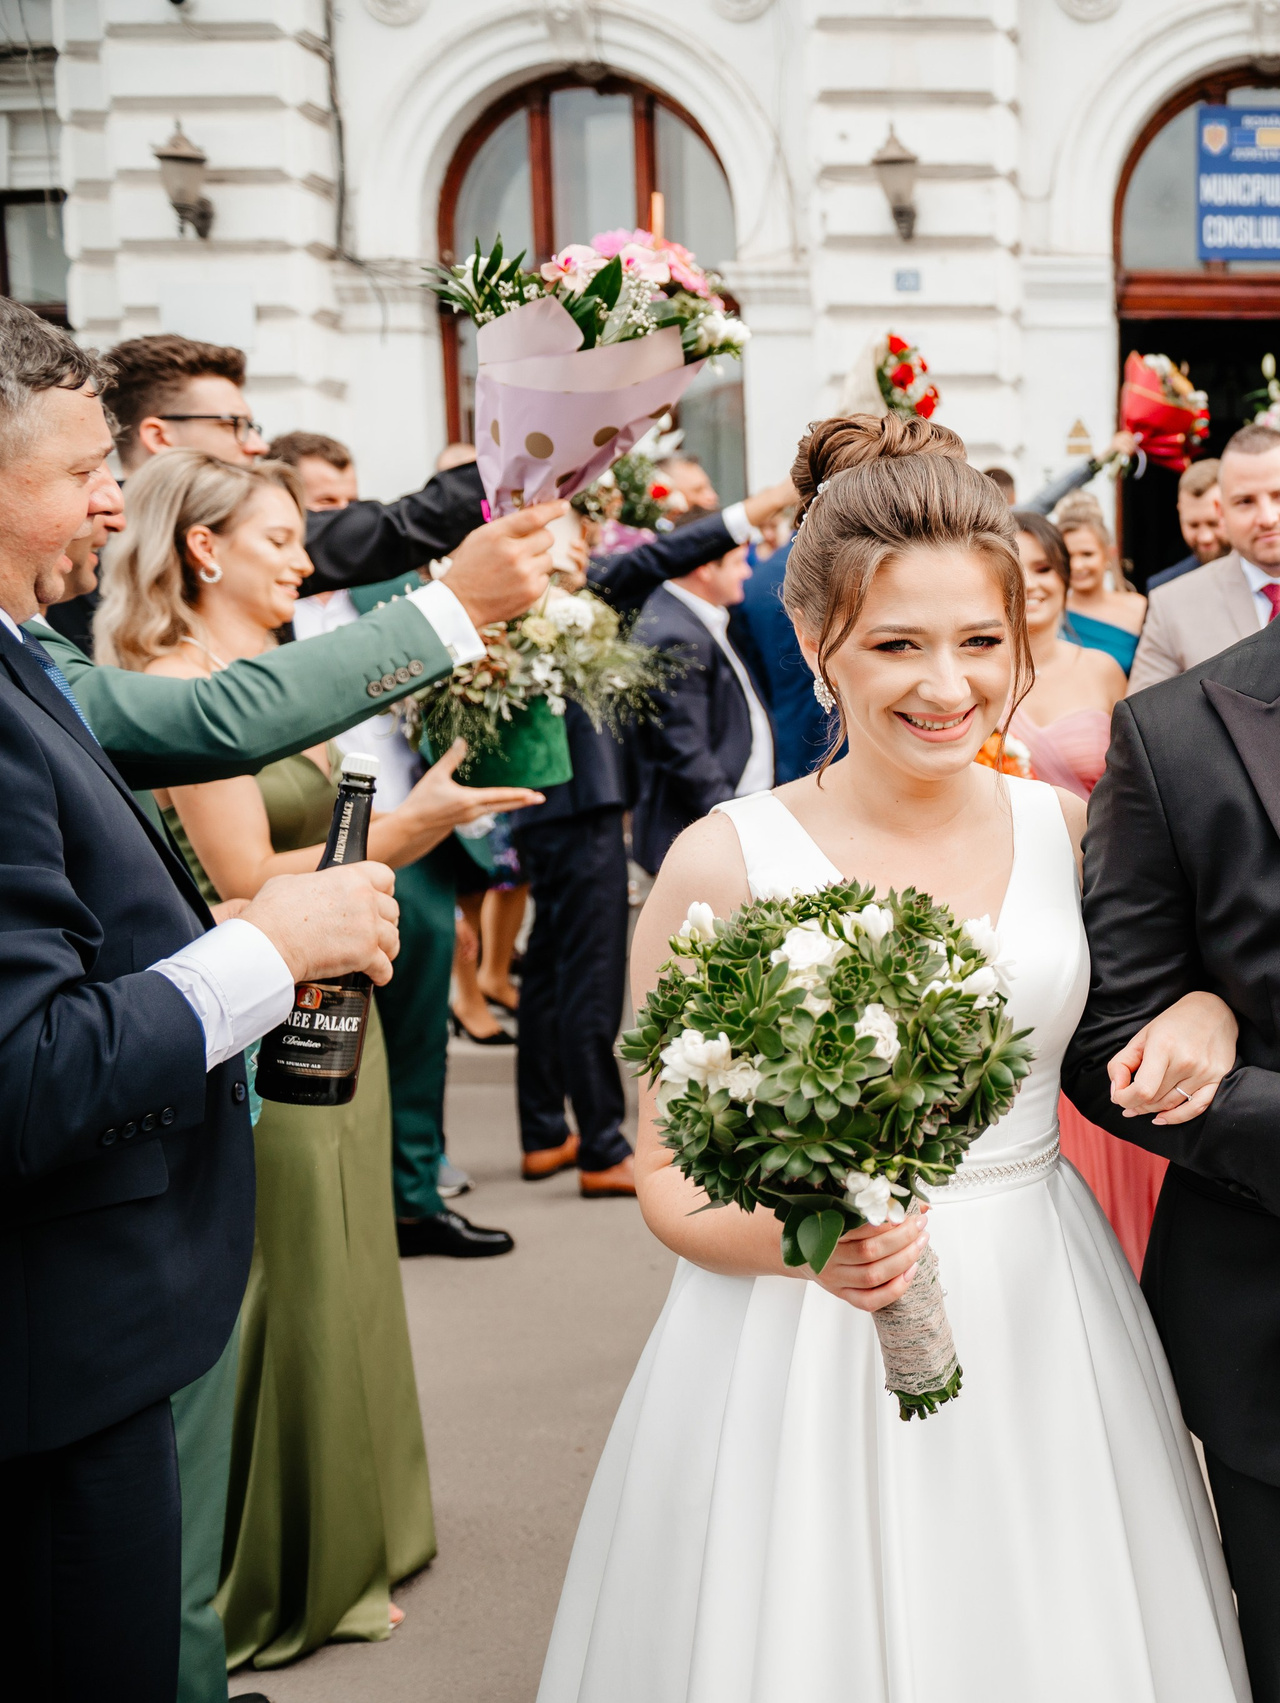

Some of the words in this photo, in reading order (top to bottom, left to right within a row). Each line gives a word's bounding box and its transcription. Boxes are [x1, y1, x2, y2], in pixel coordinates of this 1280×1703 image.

[340, 800, 354, 829] PALACE
[314, 1013, 360, 1032] PALACE
[282, 1035, 321, 1049] Demisec
[286, 1060, 310, 1068] SPUMANT
